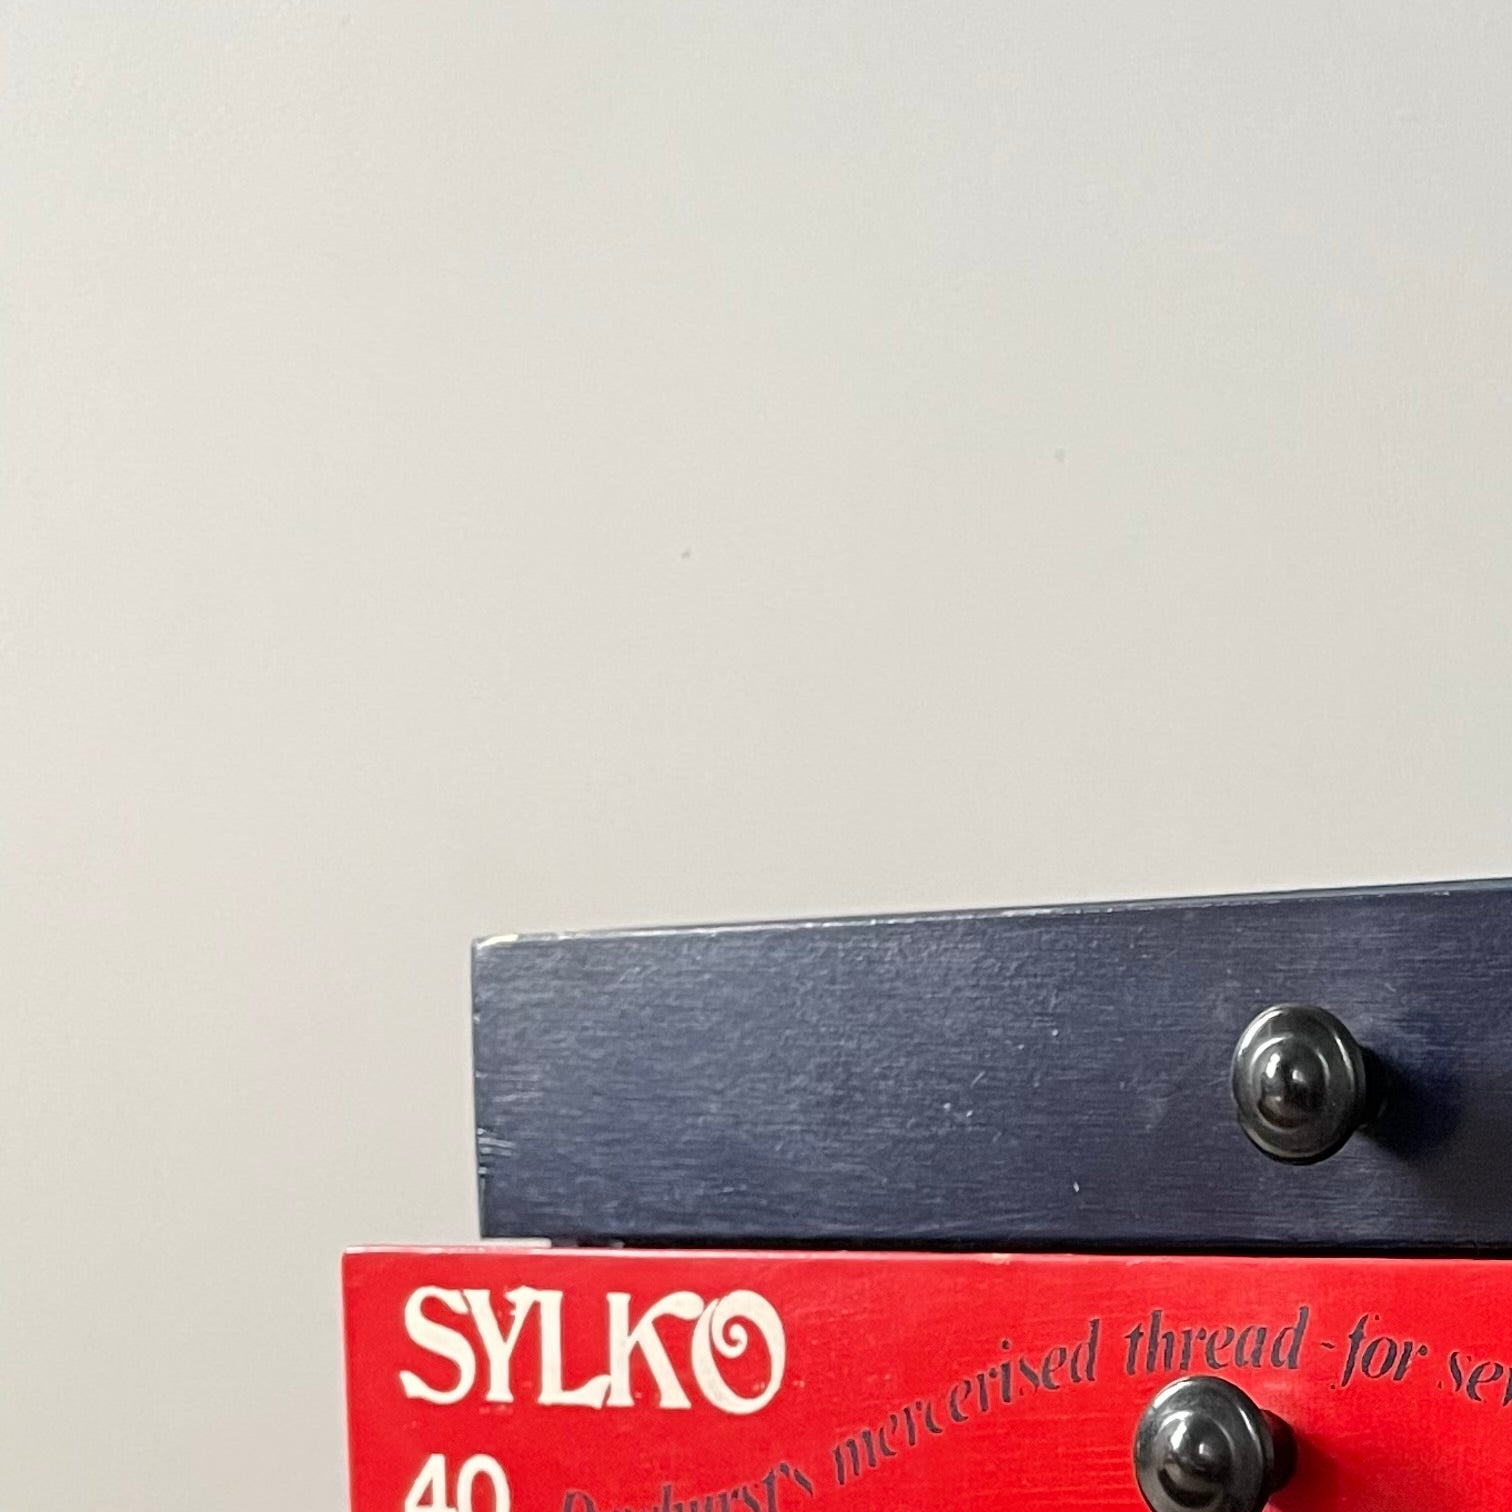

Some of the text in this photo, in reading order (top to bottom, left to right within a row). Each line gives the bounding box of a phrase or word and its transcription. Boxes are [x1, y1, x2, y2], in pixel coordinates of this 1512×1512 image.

[399, 1285, 786, 1415] SYLKO
[830, 1318, 1101, 1486] mercerised
[1123, 1306, 1309, 1376] thread
